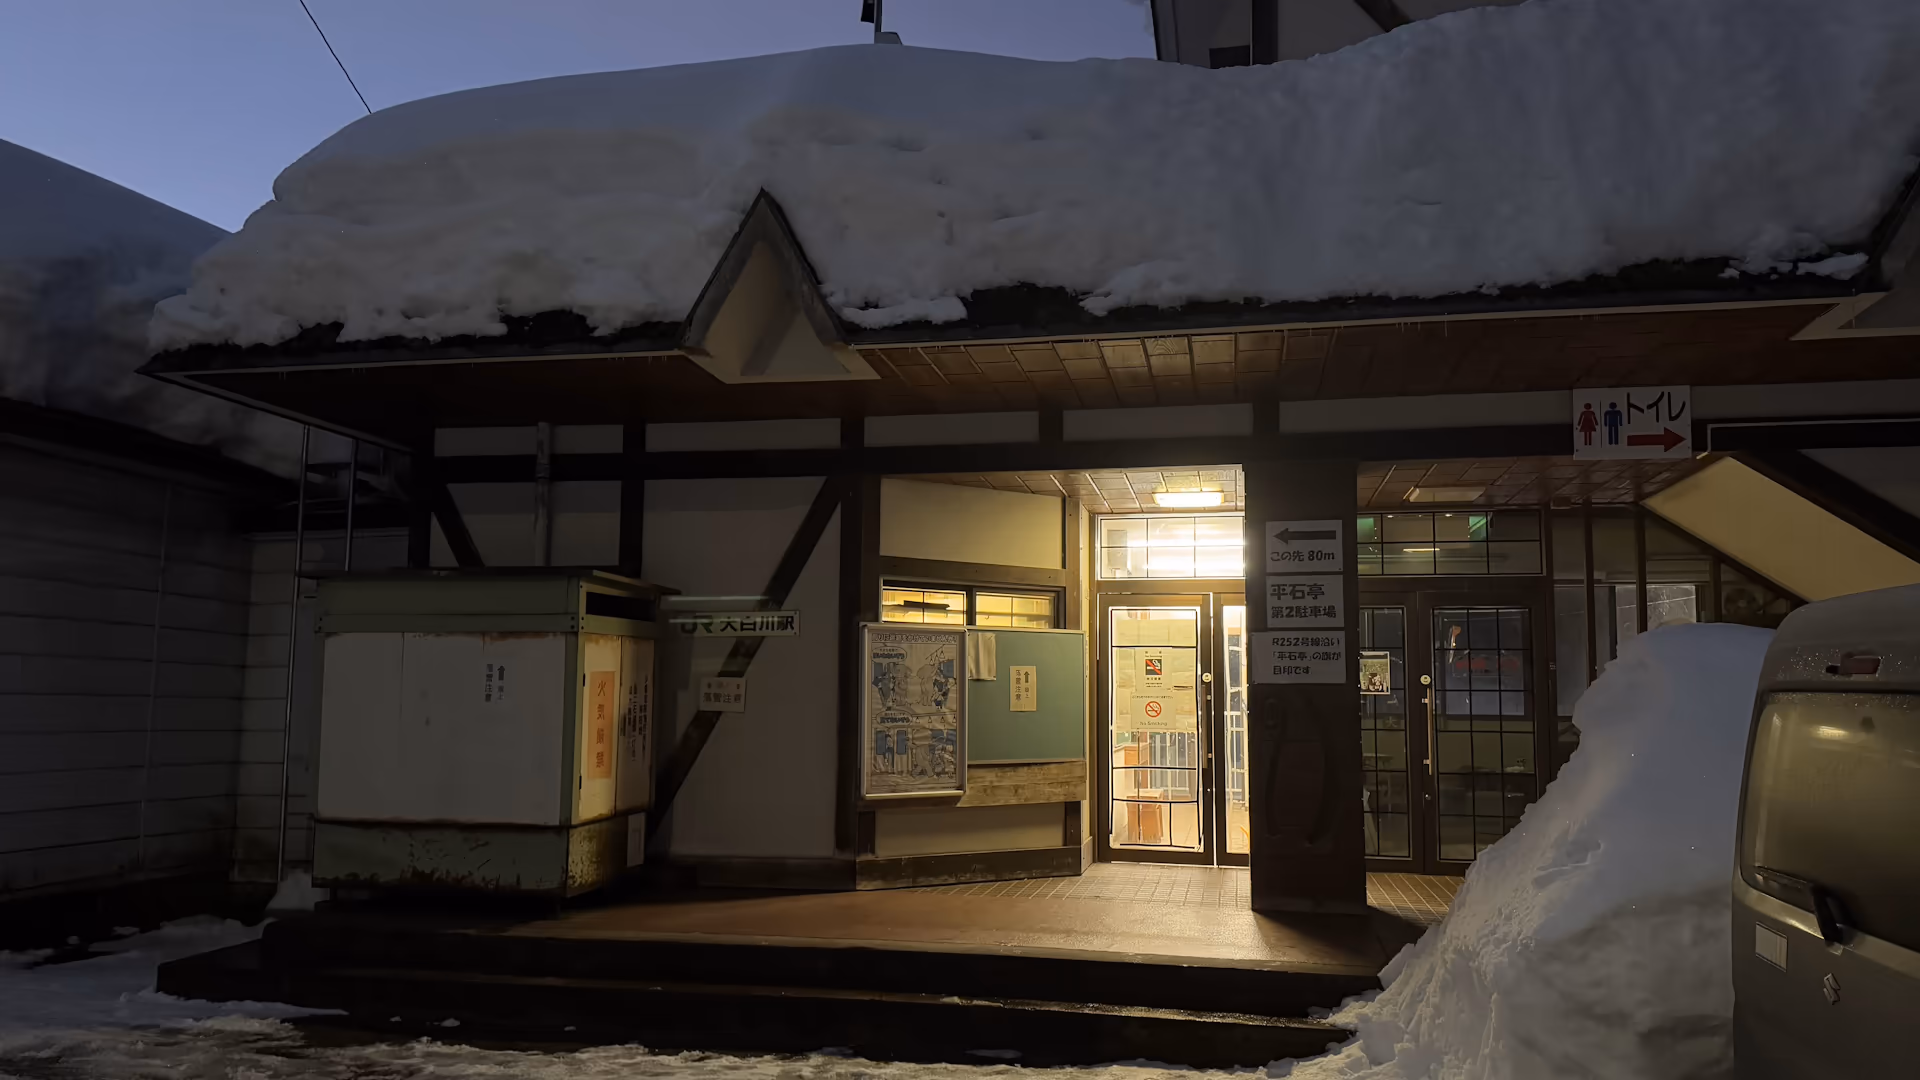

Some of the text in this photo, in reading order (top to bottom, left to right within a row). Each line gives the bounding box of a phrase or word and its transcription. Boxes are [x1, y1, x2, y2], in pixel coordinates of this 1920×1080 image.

[1626, 391, 1686, 425] トイレ
[1270, 551, 1335, 562] この先 80m
[1270, 584, 1325, 600] 平石亭
[1271, 605, 1336, 619] 第2駐車場
[719, 615, 795, 632] 大白川駅
[1272, 637, 1340, 647] R252号線沿い
[1273, 665, 1312, 675] 目印です
[596, 680, 607, 769] 火気厳禁
